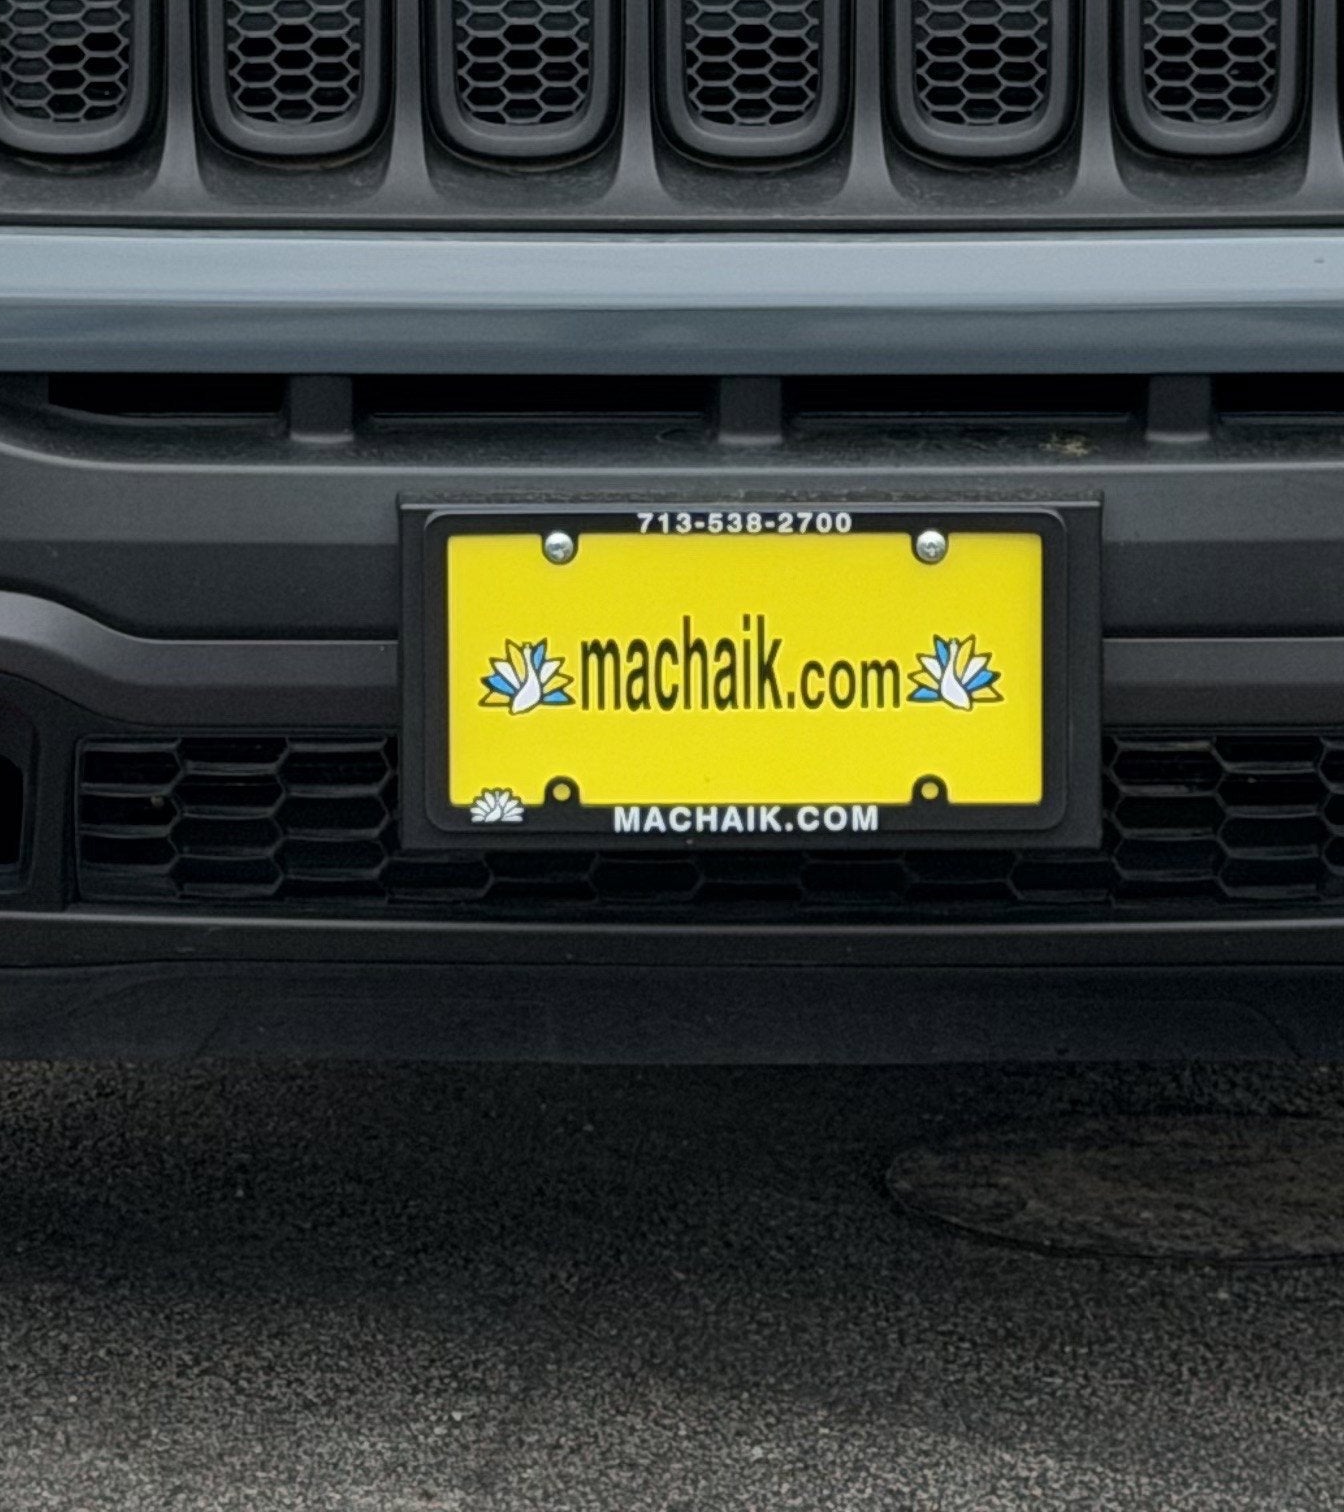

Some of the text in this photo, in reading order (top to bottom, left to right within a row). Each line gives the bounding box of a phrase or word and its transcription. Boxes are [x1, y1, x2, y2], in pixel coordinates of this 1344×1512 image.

[636, 511, 853, 534] 713-538-2700
[579, 613, 902, 712] machaik.com
[613, 805, 880, 834] MACHAIK.COM
